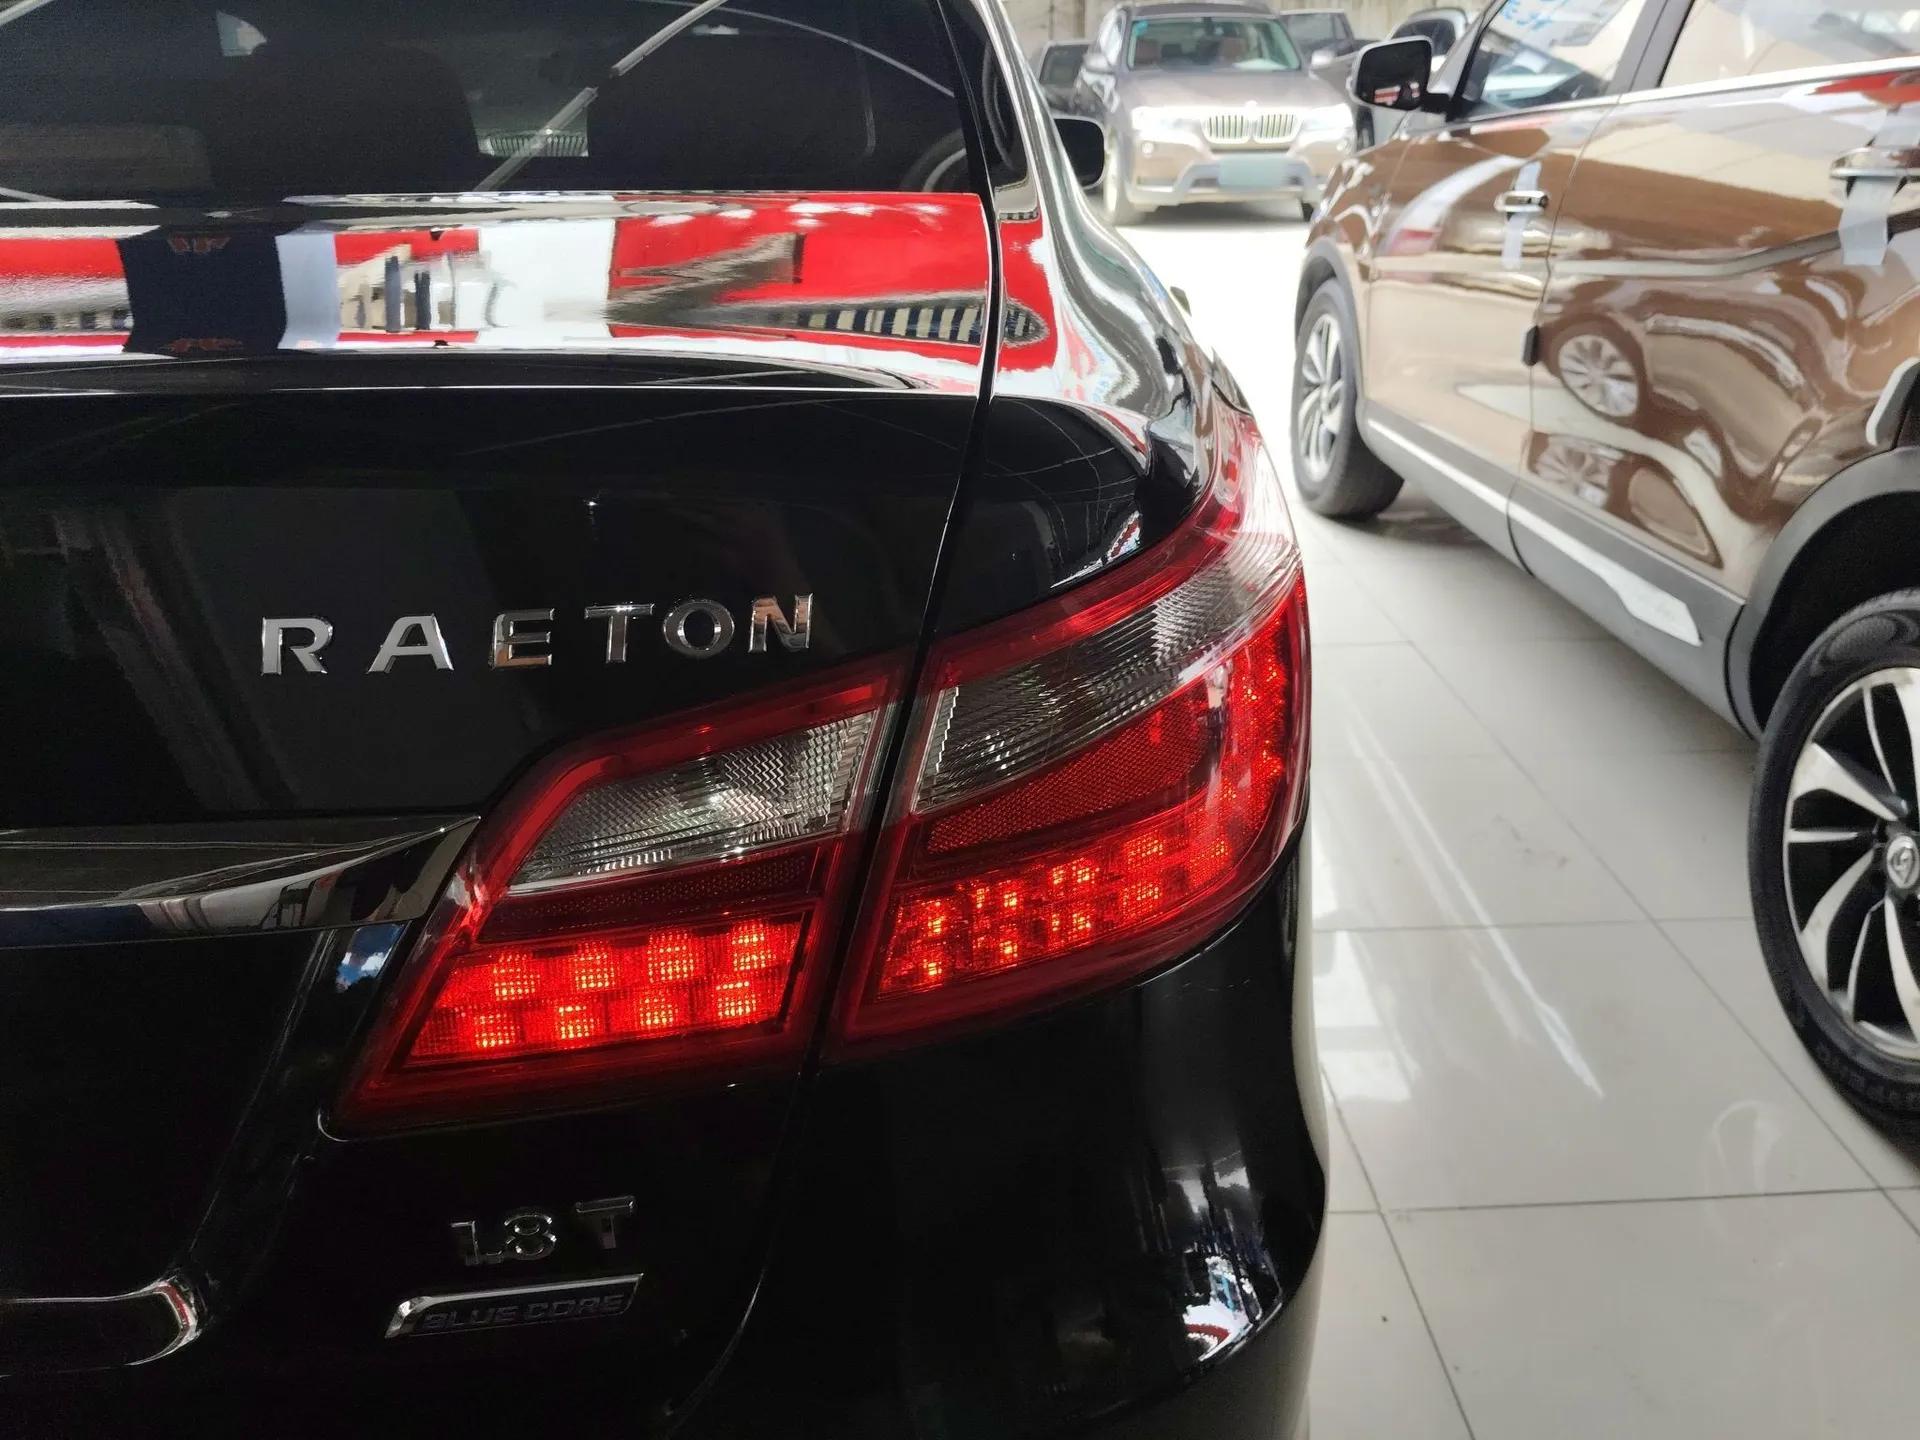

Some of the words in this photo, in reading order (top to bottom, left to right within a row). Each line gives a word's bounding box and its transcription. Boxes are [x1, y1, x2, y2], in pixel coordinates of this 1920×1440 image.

[261, 592, 814, 676] RAETON
[422, 1305, 519, 1330] BLUE
[526, 1294, 625, 1318] CORE
